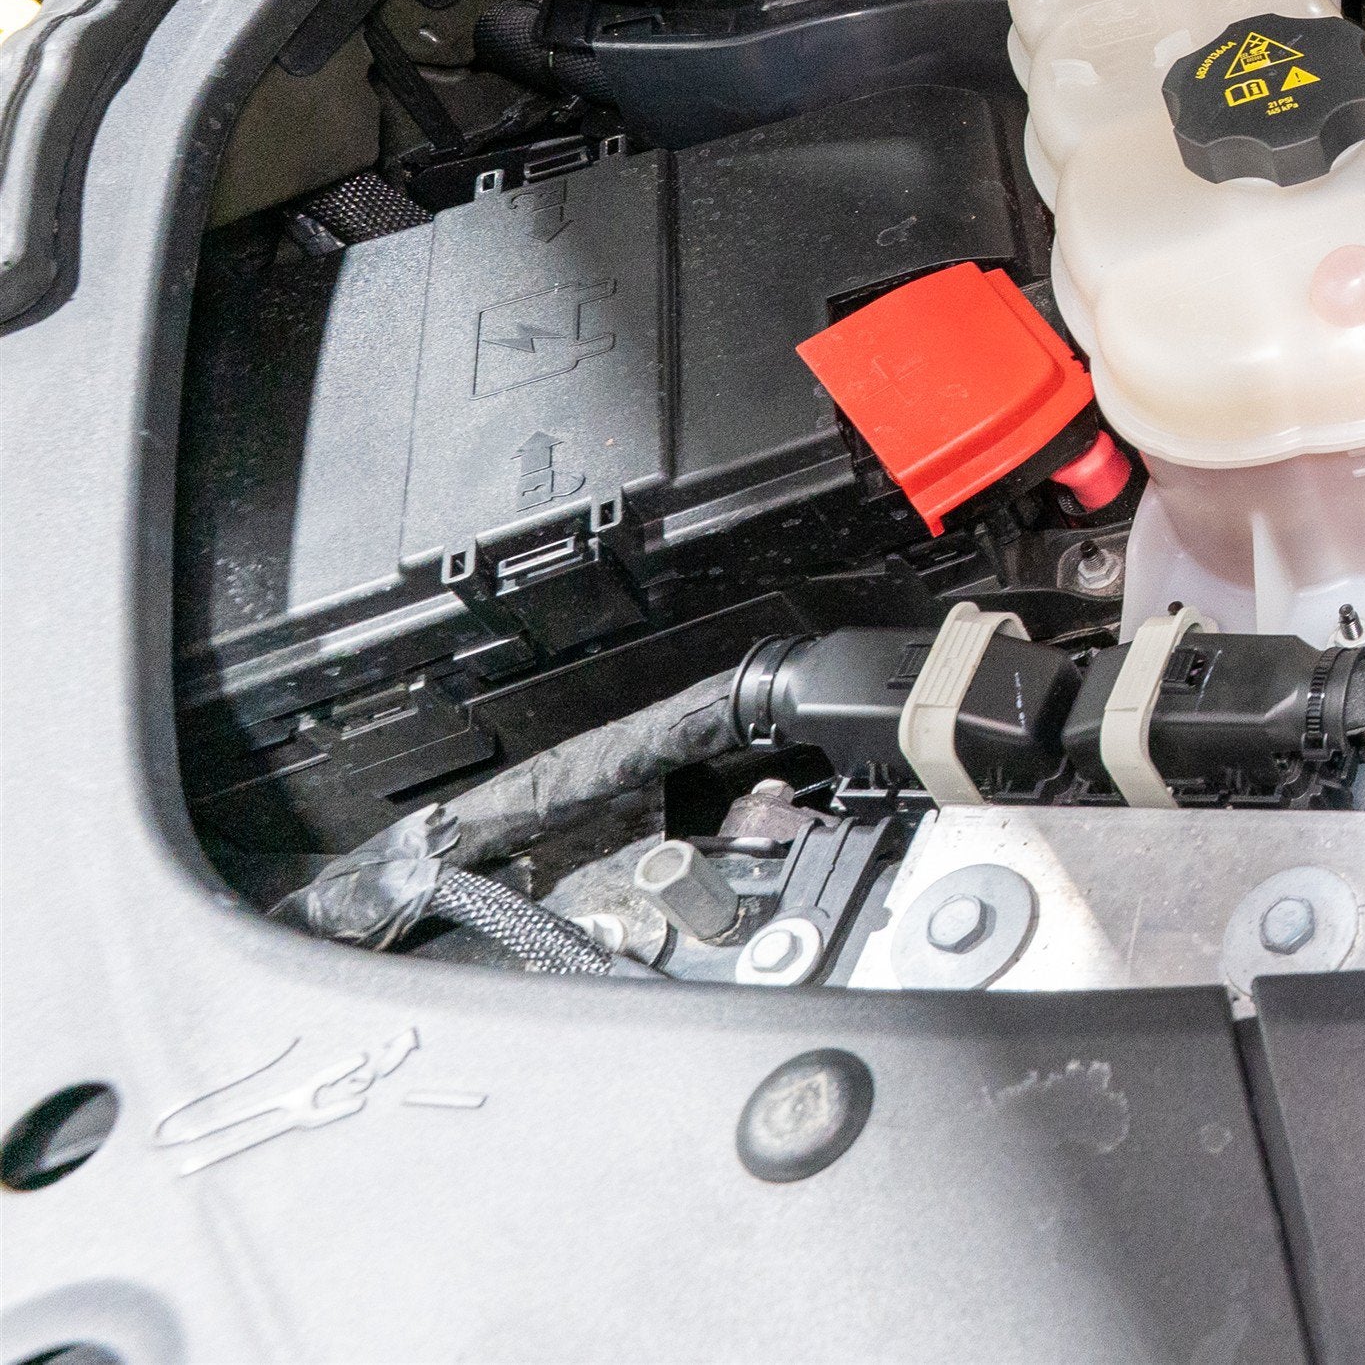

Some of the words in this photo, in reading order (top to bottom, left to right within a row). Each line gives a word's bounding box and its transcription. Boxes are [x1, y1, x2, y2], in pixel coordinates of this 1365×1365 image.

[1268, 100, 1278, 109] 21
[1278, 96, 1294, 105] PSI
[1281, 102, 1299, 112] kPa
